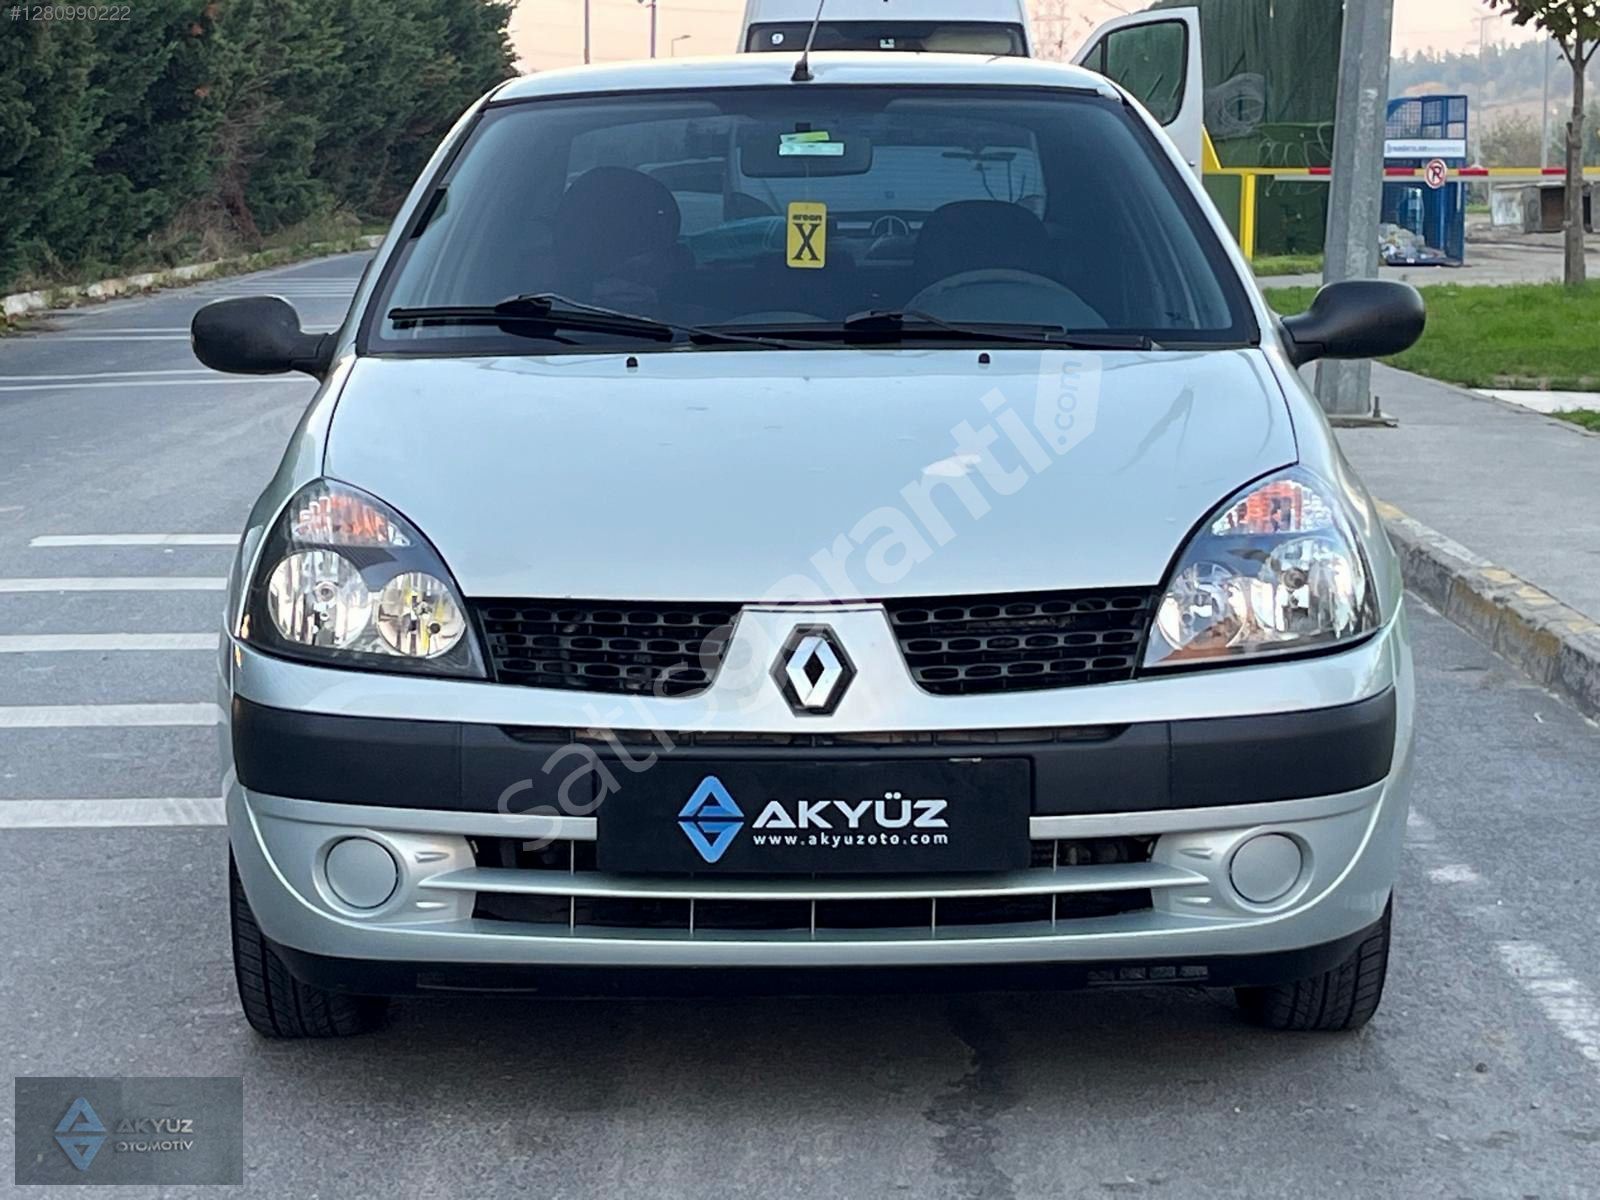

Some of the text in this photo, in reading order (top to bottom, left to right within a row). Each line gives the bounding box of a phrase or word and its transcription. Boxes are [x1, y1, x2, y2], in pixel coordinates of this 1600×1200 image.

[792, 222, 821, 261] X
[752, 791, 949, 828] AKYÜZ
[753, 832, 949, 848] www.akyuzoto.com
